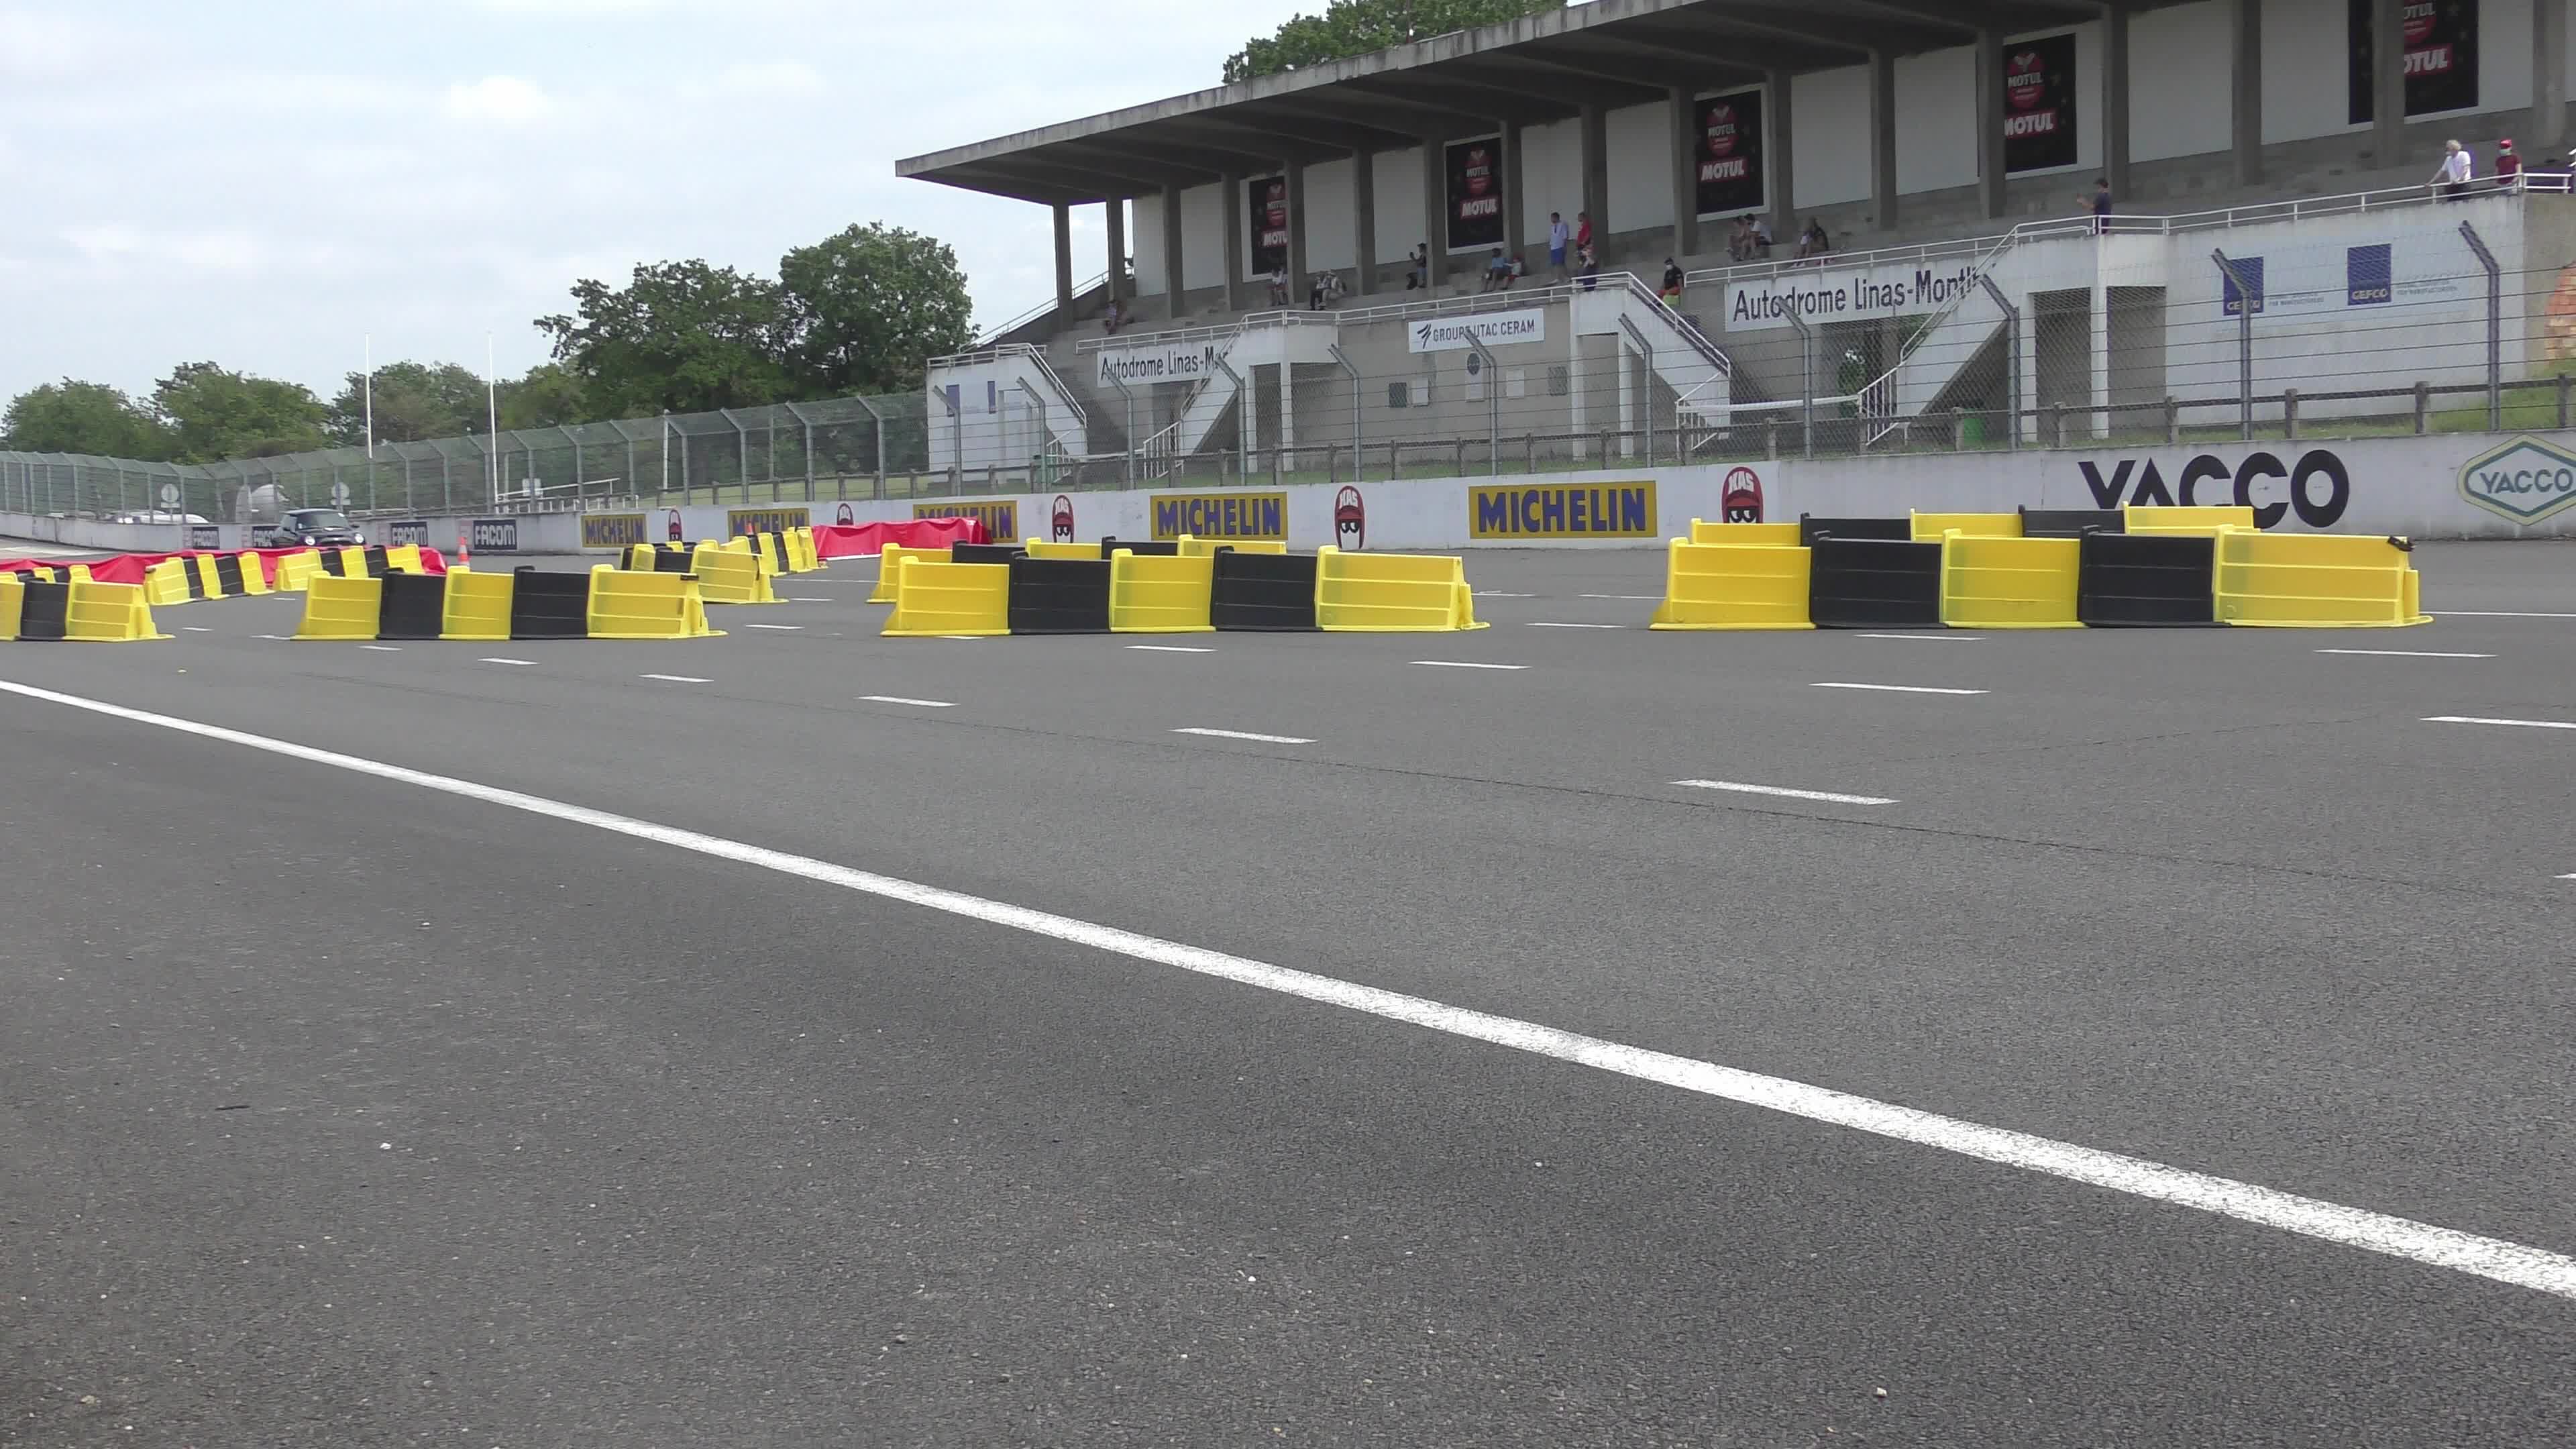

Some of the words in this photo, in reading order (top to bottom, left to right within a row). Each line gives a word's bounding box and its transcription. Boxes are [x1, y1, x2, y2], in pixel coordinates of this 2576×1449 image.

[2404, 3, 2436, 19] OTUL
[2404, 49, 2447, 74] OTUL
[2007, 72, 2043, 87] MOTUL
[2004, 113, 2053, 136] MOTUL
[1701, 160, 1744, 181] MOTUL
[1462, 199, 1497, 217] MOTUL
[1264, 231, 1287, 246] MOTU
[1733, 286, 1846, 322] Autodrome
[2352, 288, 2387, 300] GEFCO
[1473, 323, 1498, 337] UTAC
[1501, 319, 1535, 335] CERAM
[2479, 468, 2573, 493] YACCO
[1157, 498, 1281, 536] MICHELIN
[1478, 488, 1646, 533] MICHELIN
[391, 526, 427, 545] FACOM
[475, 524, 515, 545] FACOM
